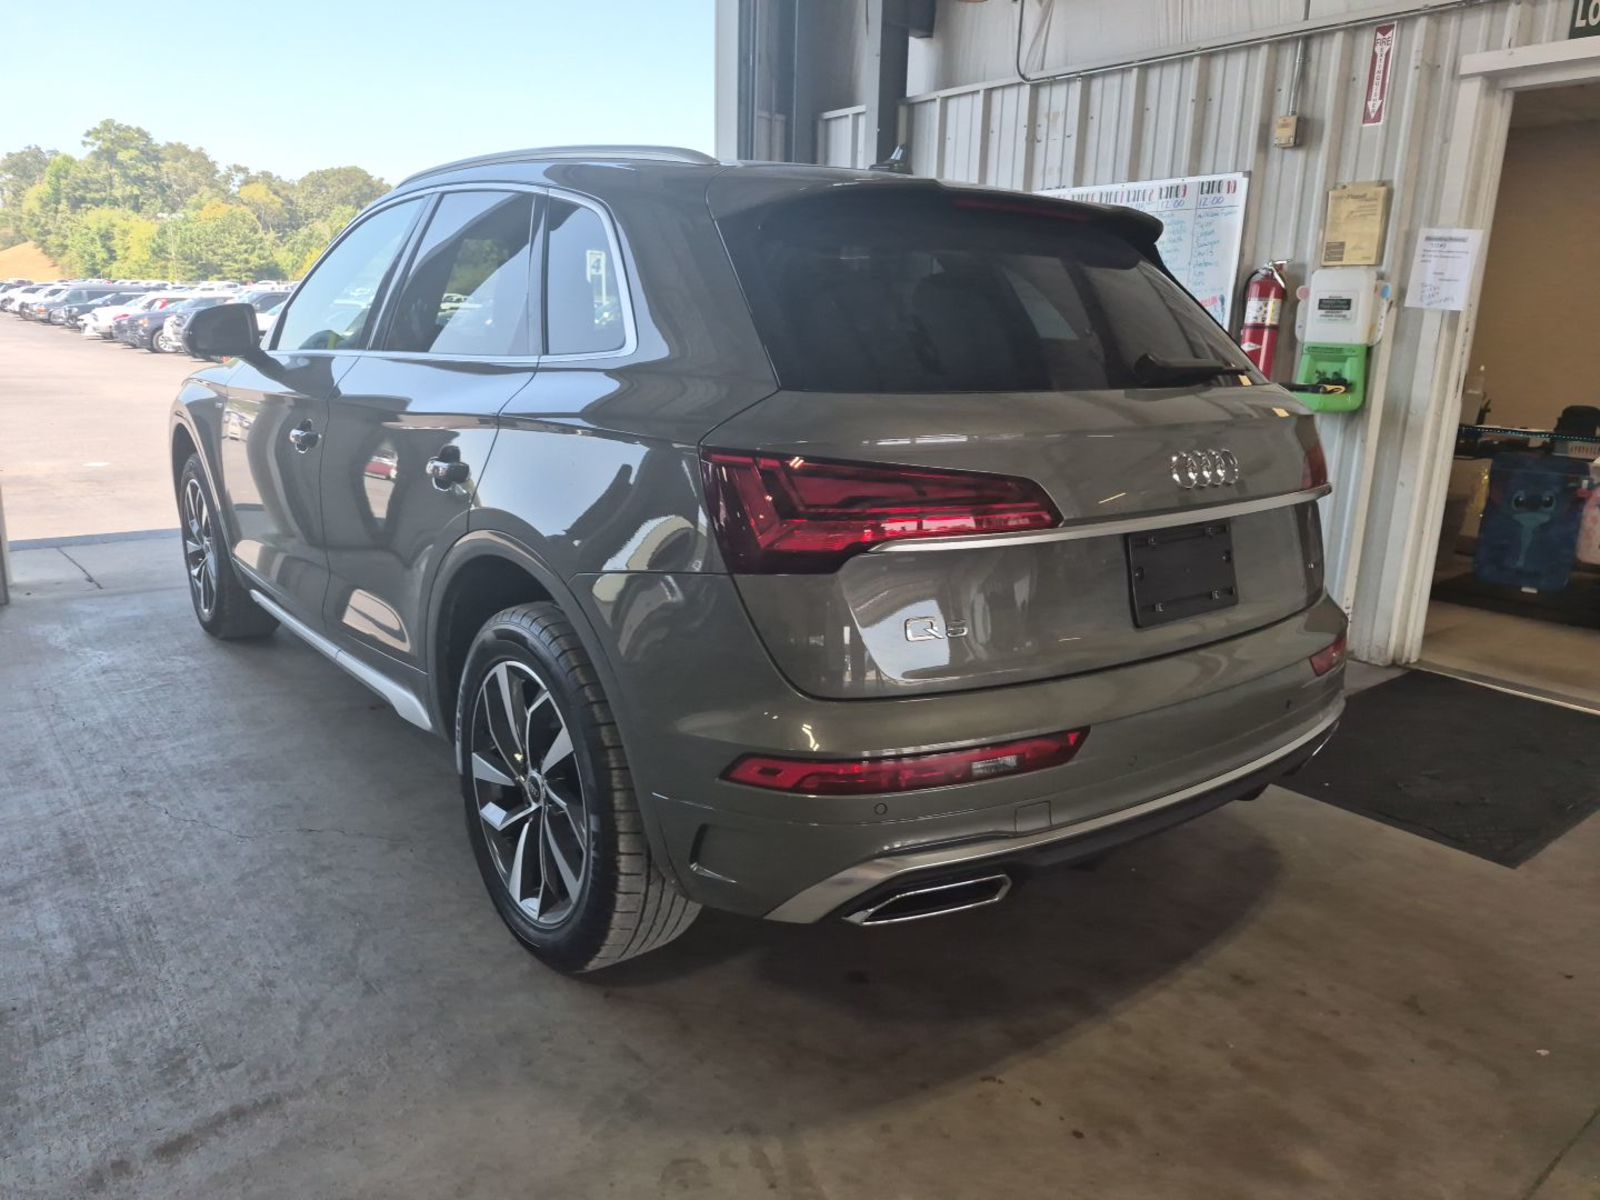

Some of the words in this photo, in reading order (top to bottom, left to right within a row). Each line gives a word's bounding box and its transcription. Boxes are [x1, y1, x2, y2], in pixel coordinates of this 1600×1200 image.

[1376, 36, 1391, 46] FIRE
[1371, 47, 1384, 114] EXTINGUISHER
[904, 616, 968, 642] Q5
